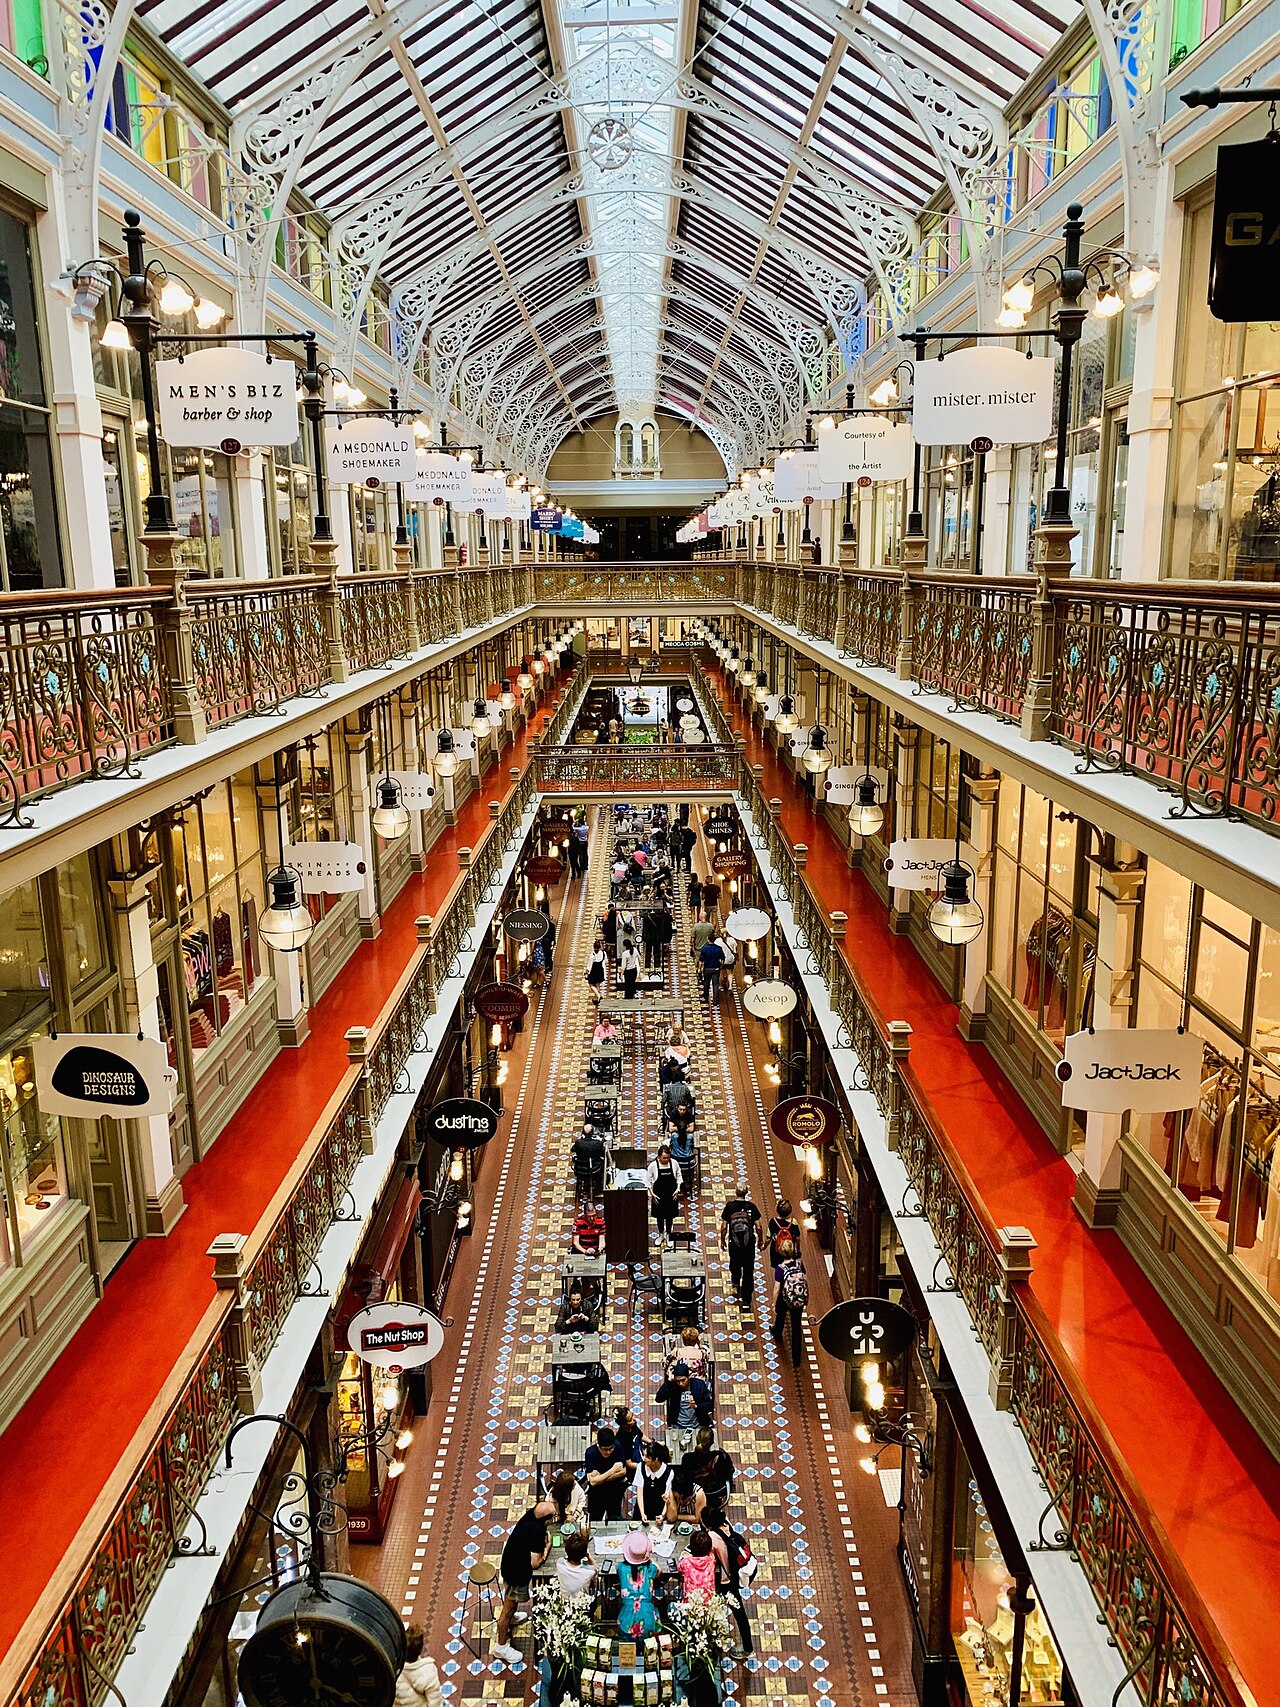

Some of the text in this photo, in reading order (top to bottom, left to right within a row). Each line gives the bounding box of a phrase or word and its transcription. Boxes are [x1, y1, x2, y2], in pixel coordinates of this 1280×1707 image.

[169, 384, 283, 398] MEN'S BIZ
[182, 406, 273, 423] barber & shop
[844, 430, 886, 440] Courtesy of
[222, 441, 238, 451] 127
[332, 443, 340, 454] A
[972, 440, 991, 450] 126
[342, 458, 401, 469] SHOEMAKER
[861, 462, 882, 470] Artist
[415, 483, 461, 491] SHOEMAKER
[714, 860, 747, 868] SHOPPING
[509, 921, 543, 929] NIESSING
[752, 993, 788, 1005] Aesop
[481, 1004, 521, 1012] COOMBS
[82, 1071, 136, 1083] DINOSAUR
[1084, 1063, 1182, 1080] Jac+Jack
[84, 1084, 136, 1096] DESIGNS
[435, 1114, 489, 1129] dustins
[366, 1330, 425, 1344] The Nut Shop
[347, 1520, 366, 1529] 1939
